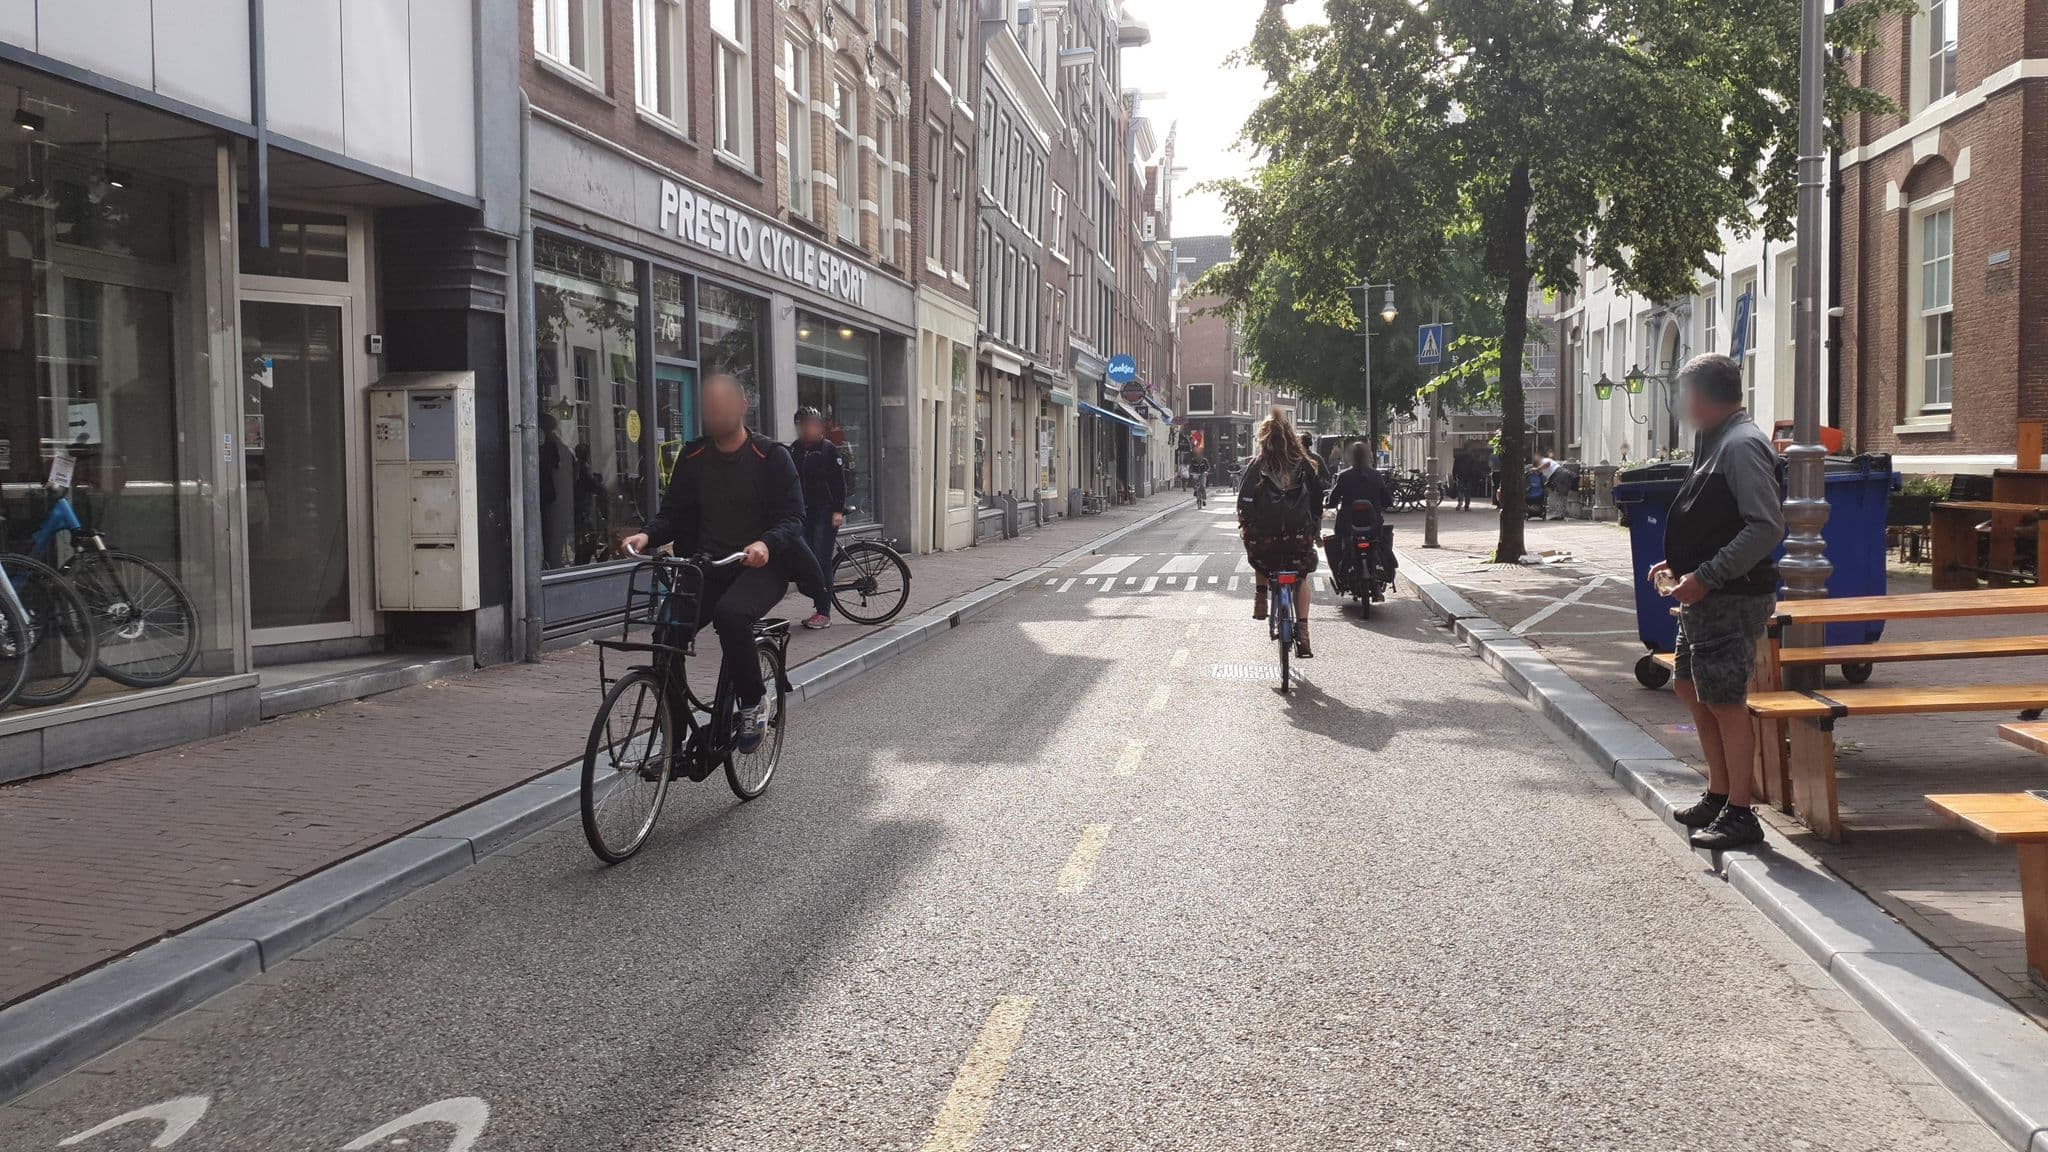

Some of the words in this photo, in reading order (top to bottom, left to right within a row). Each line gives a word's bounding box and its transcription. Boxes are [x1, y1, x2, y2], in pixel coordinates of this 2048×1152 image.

[660, 179, 754, 262] PRESTO
[760, 225, 815, 287] CYCLE
[818, 251, 867, 306] SPORT
[659, 313, 676, 342] 76
